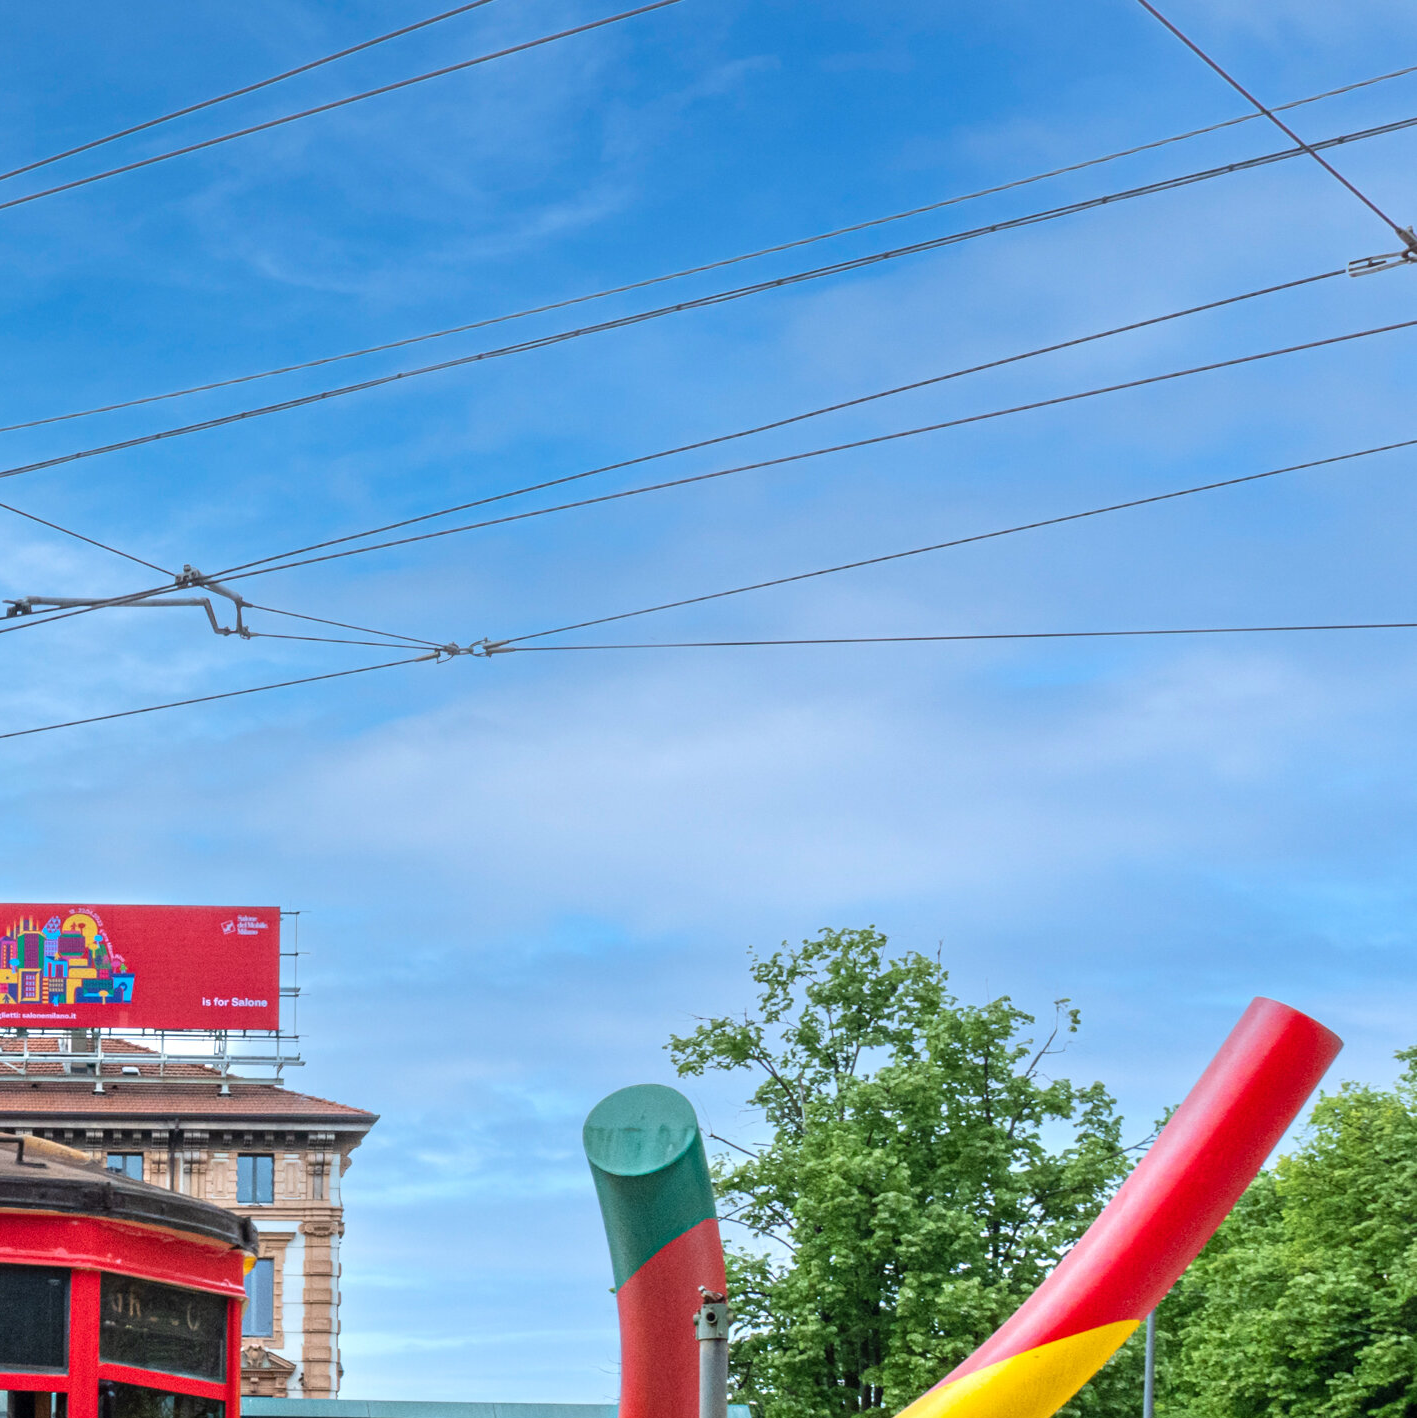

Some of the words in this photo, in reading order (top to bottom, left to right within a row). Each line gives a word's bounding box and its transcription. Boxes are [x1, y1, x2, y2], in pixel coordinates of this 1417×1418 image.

[202, 997, 211, 1007] is
[213, 997, 229, 1007] for
[231, 997, 268, 1008] Salone
